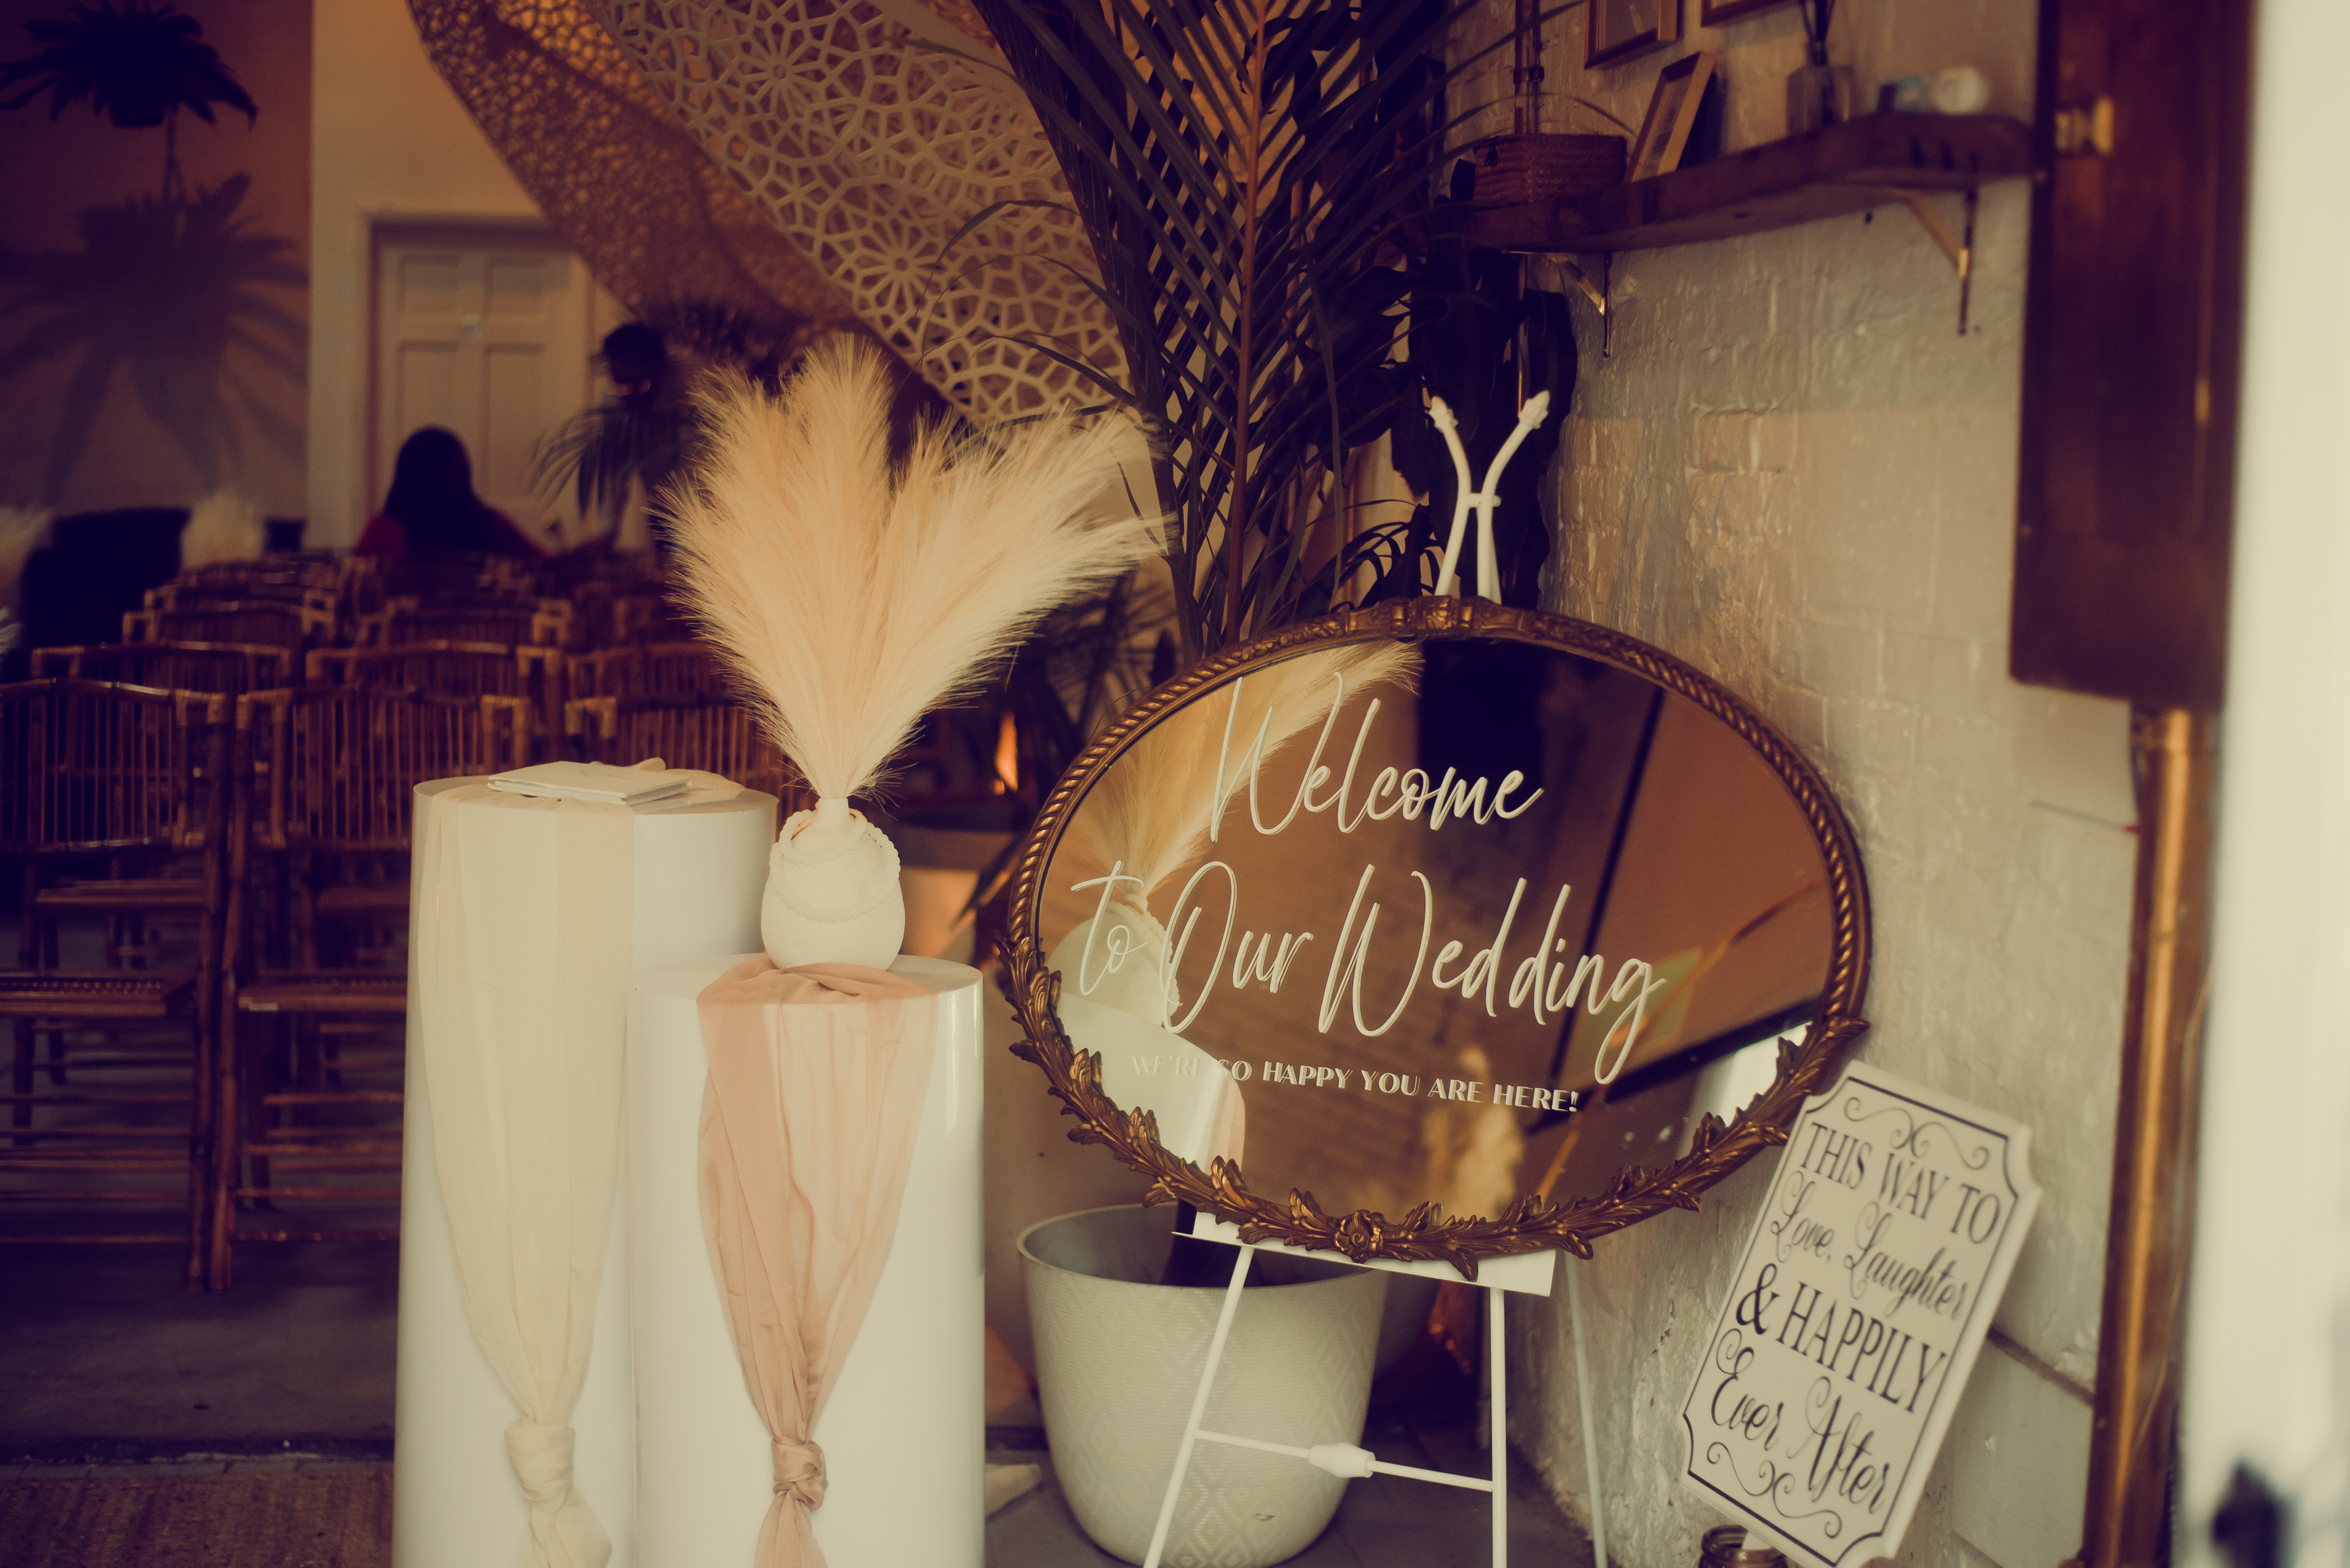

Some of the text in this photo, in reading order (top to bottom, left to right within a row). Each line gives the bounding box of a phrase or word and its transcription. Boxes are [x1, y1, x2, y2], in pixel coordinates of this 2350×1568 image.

[1210, 671, 1545, 843] Welcome
[1070, 859, 1668, 1085] to Our Wedding
[1131, 1055, 1580, 1113] WE'RE SO HAPPY YOU ARE HERE!
[1770, 1170, 1970, 1321] Love, Laughter
[1799, 1121, 2002, 1244] THIS WAY TO
[1735, 1263, 1949, 1415] & HAPPILY
[1710, 1328, 1892, 1515] Ever After
